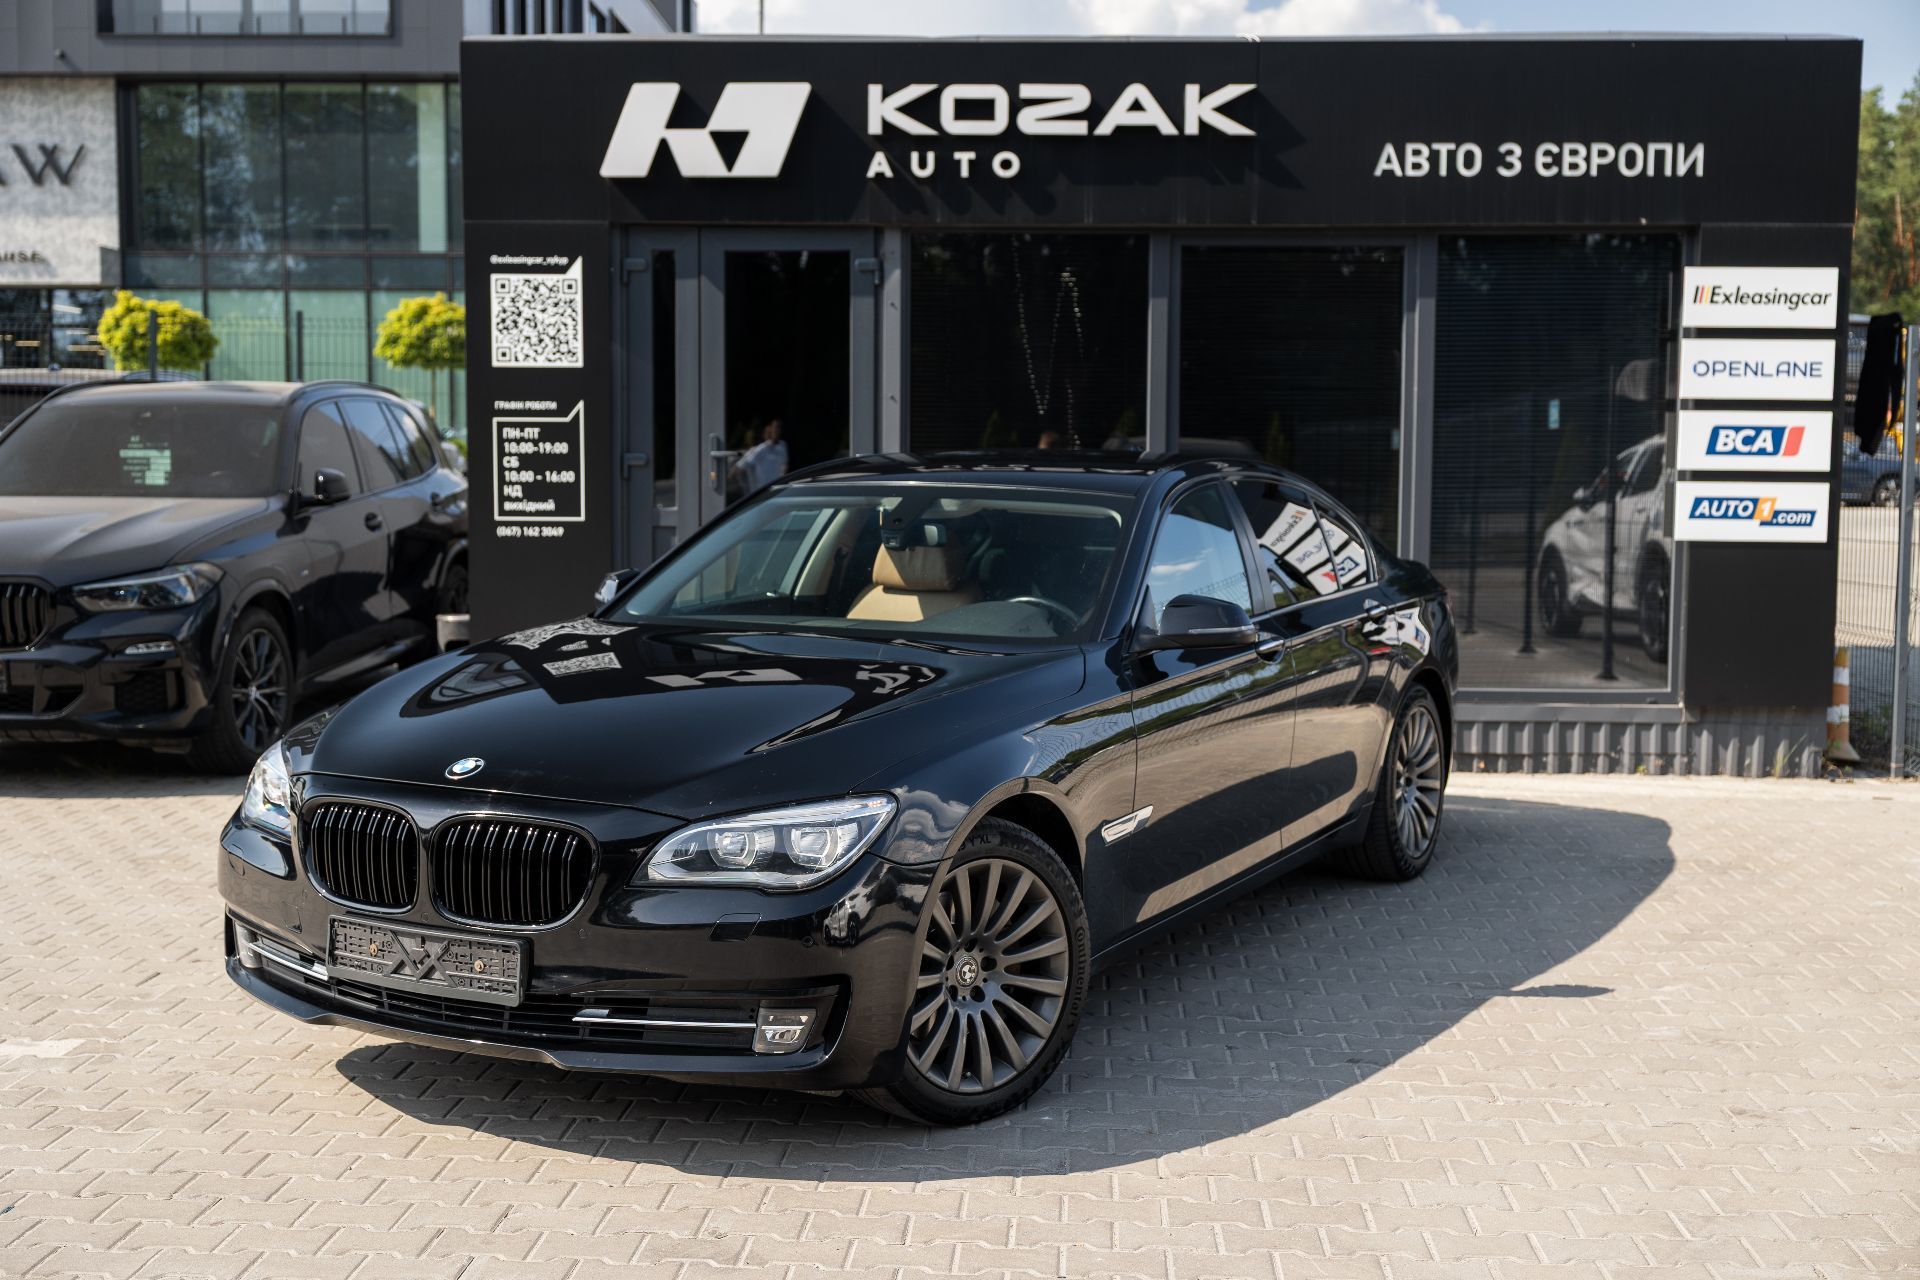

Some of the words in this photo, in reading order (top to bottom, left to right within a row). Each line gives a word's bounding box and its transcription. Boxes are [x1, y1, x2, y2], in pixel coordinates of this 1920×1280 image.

[867, 83, 1257, 136] KOZAK
[0, 144, 85, 186] W
[867, 151, 1021, 178] AUTO
[1374, 143, 1483, 177] АВТО
[1496, 143, 1523, 177] З
[1535, 143, 1705, 177] ЄВРОПИ
[1709, 285, 1832, 310] Exleasingcar
[1693, 360, 1823, 378] OPENLANE
[502, 427, 541, 440] ПН-ПТ
[1715, 428, 1775, 453] BCA
[502, 455, 520, 469] СБ
[504, 470, 535, 483] 10:00
[545, 470, 576, 483] 16:00
[503, 484, 523, 498] НД
[1070, 926, 1086, 1018] Continental
